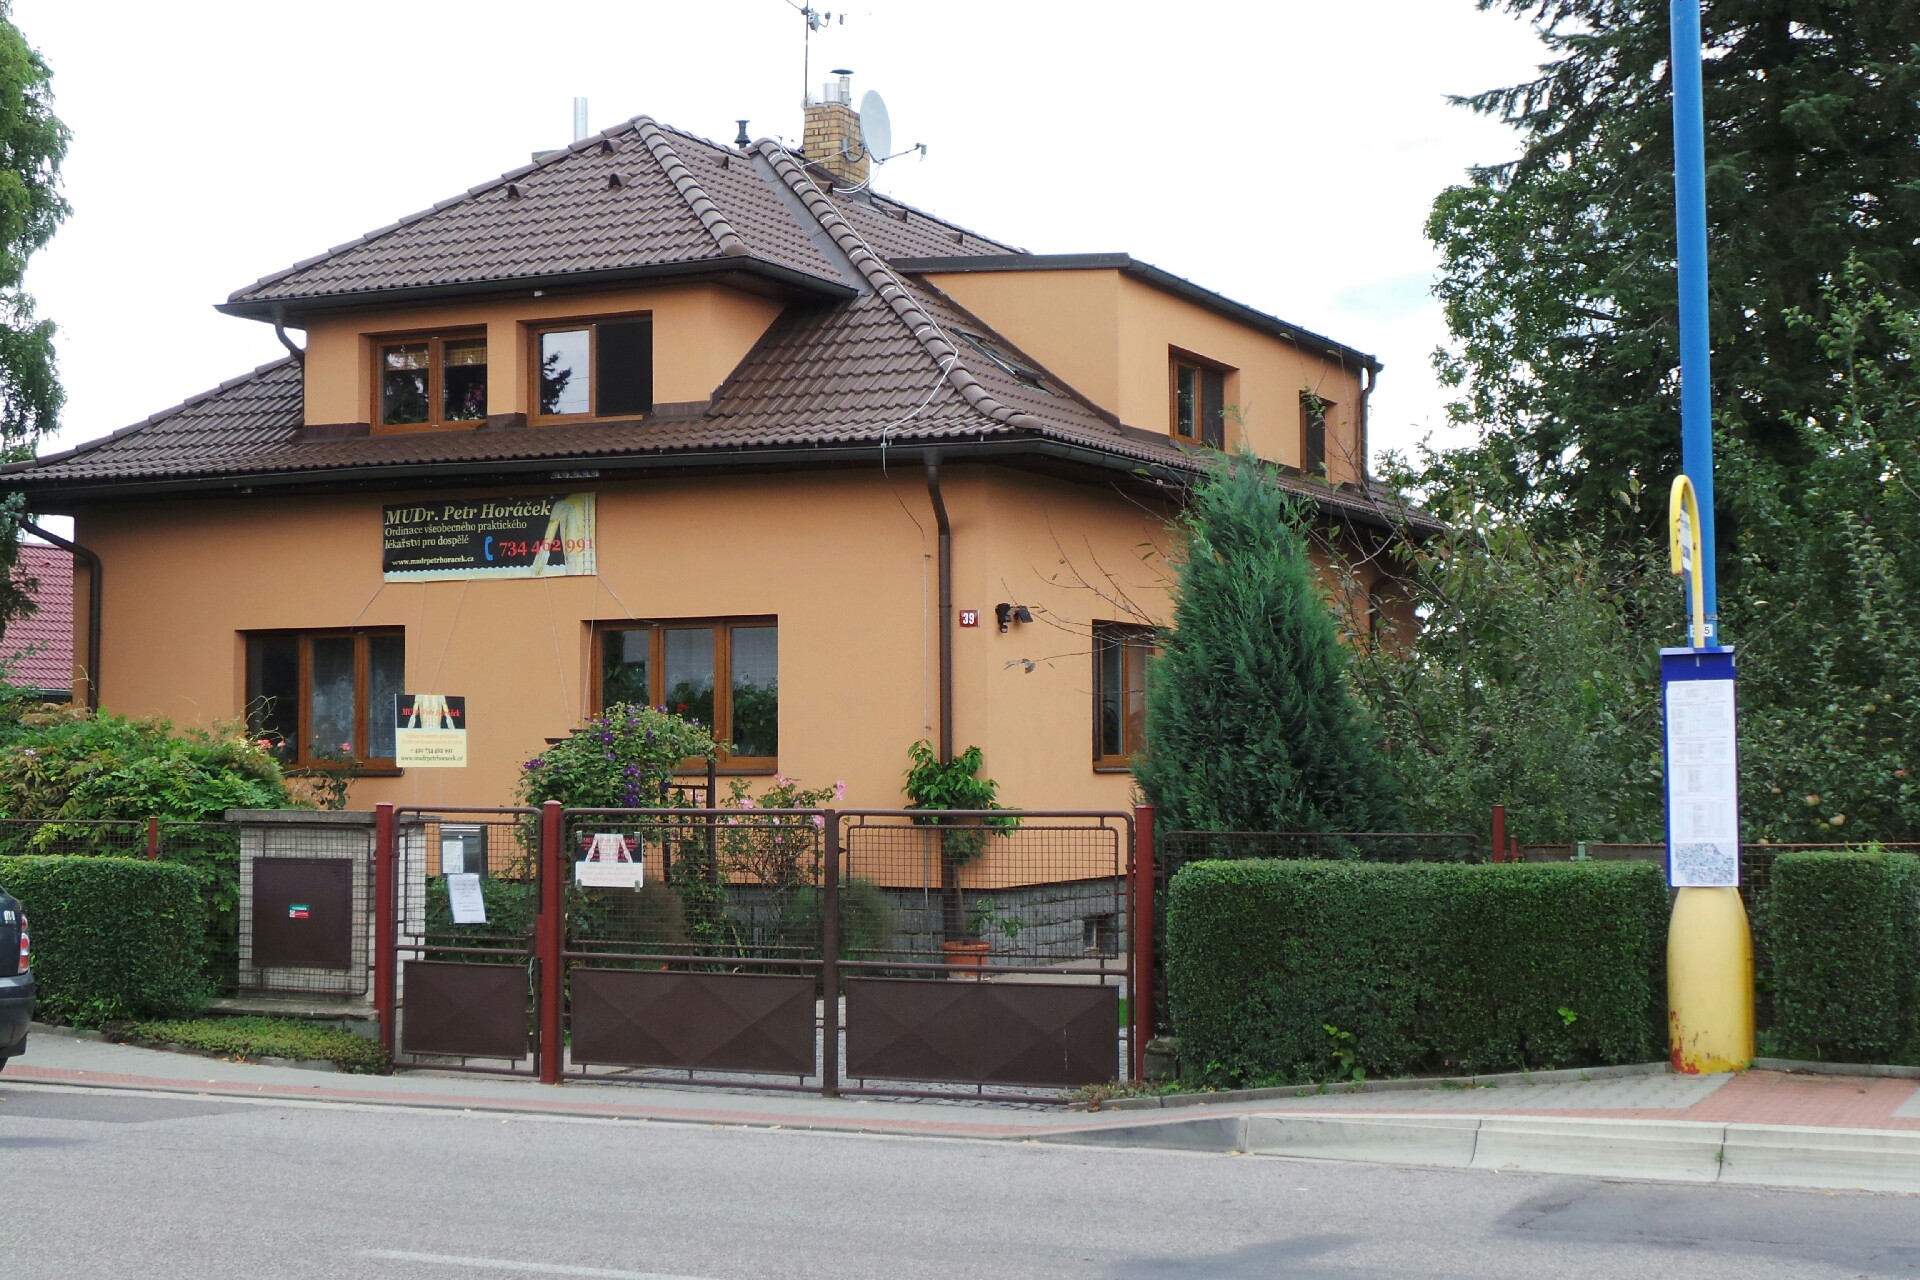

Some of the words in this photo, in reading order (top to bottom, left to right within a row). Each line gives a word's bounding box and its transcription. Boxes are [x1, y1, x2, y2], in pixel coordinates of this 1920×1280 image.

[385, 507, 439, 525] MUDr.
[443, 505, 478, 521] Petr
[480, 500, 551, 518] Horáček
[385, 526, 422, 537] Ordinace
[424, 521, 476, 533] všeobecného
[477, 519, 527, 533] praktického
[385, 538, 420, 549] lékařství
[421, 539, 436, 548] pro
[437, 535, 469, 547] dospělé
[499, 541, 528, 556] 734
[531, 538, 562, 553] 462
[566, 538, 593, 553] 991
[391, 555, 475, 566] www.mudrpetrhoracek.cz
[962, 612, 975, 625] 39
